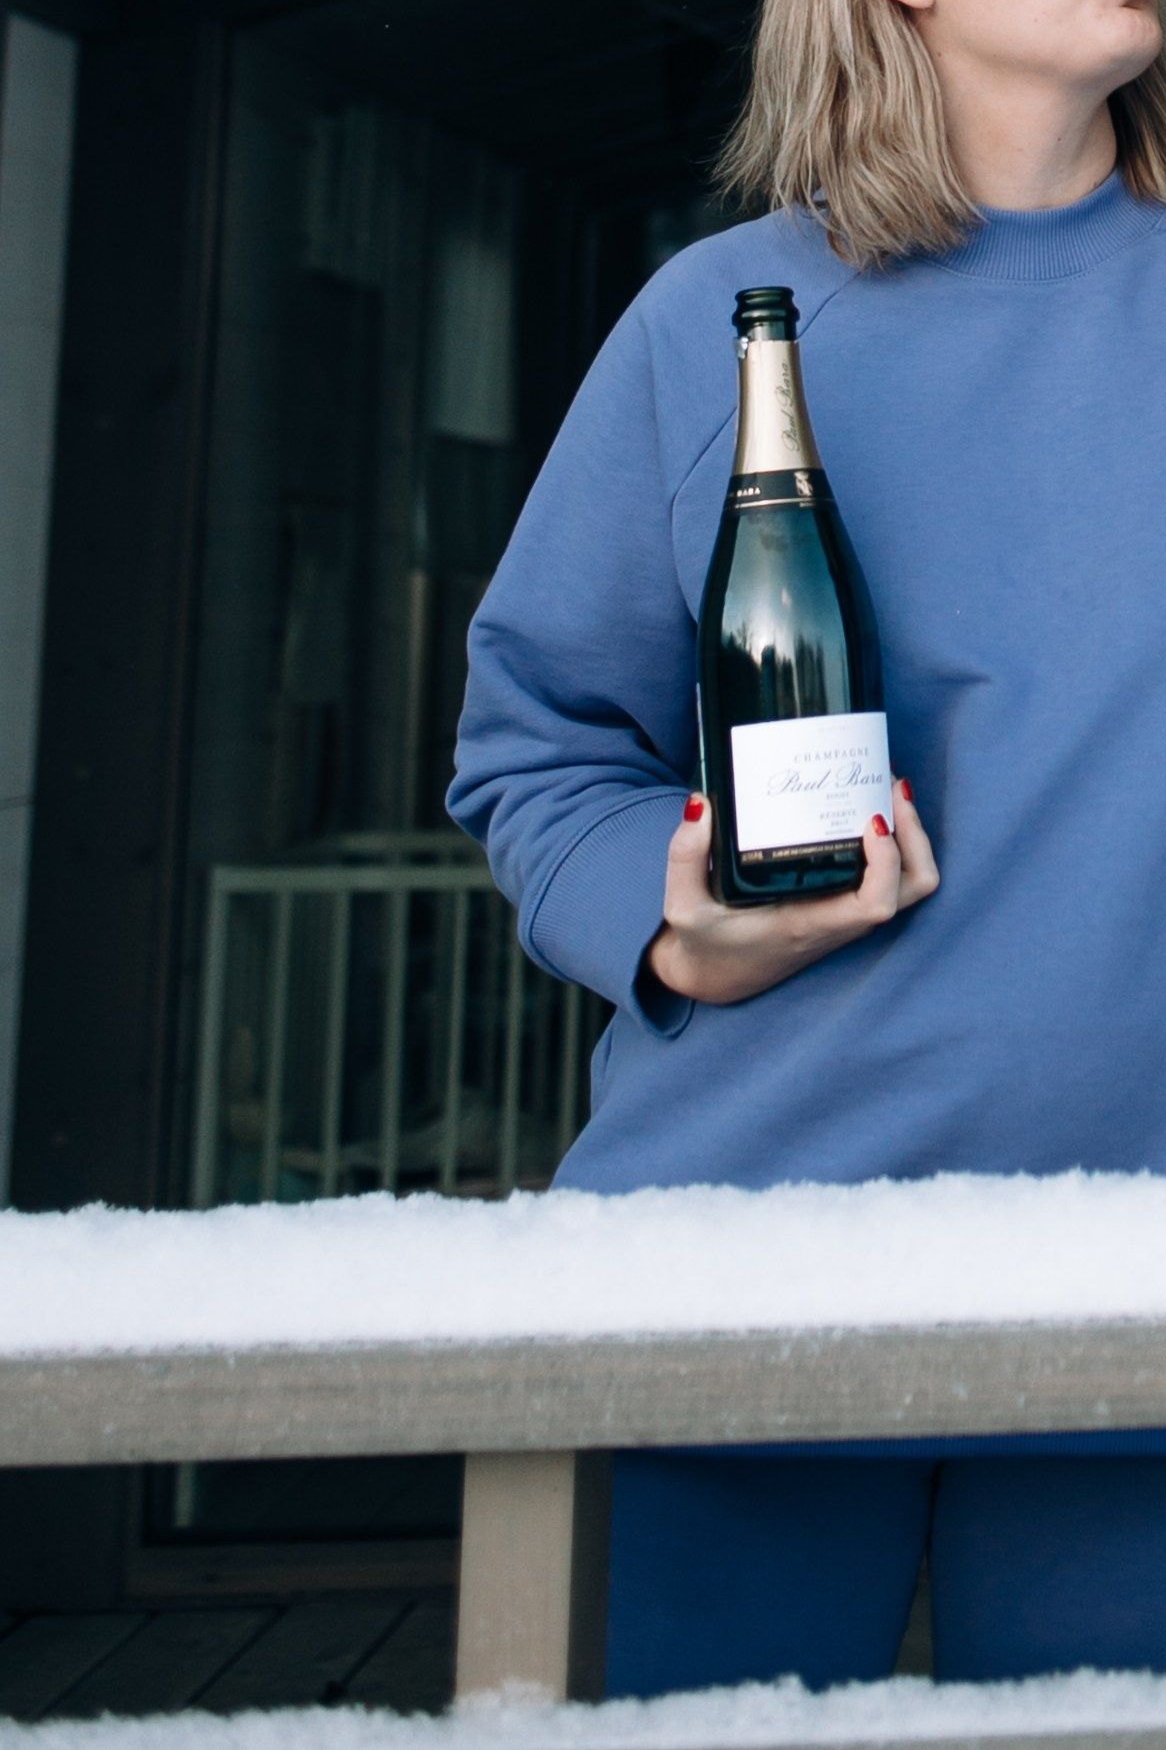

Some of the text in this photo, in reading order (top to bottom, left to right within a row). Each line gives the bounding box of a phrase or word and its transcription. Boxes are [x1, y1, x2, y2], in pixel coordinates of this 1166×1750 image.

[775, 362, 799, 452] Paul Bara
[794, 747, 869, 763] CHAMPAGNE
[767, 761, 882, 796] Paul Bara
